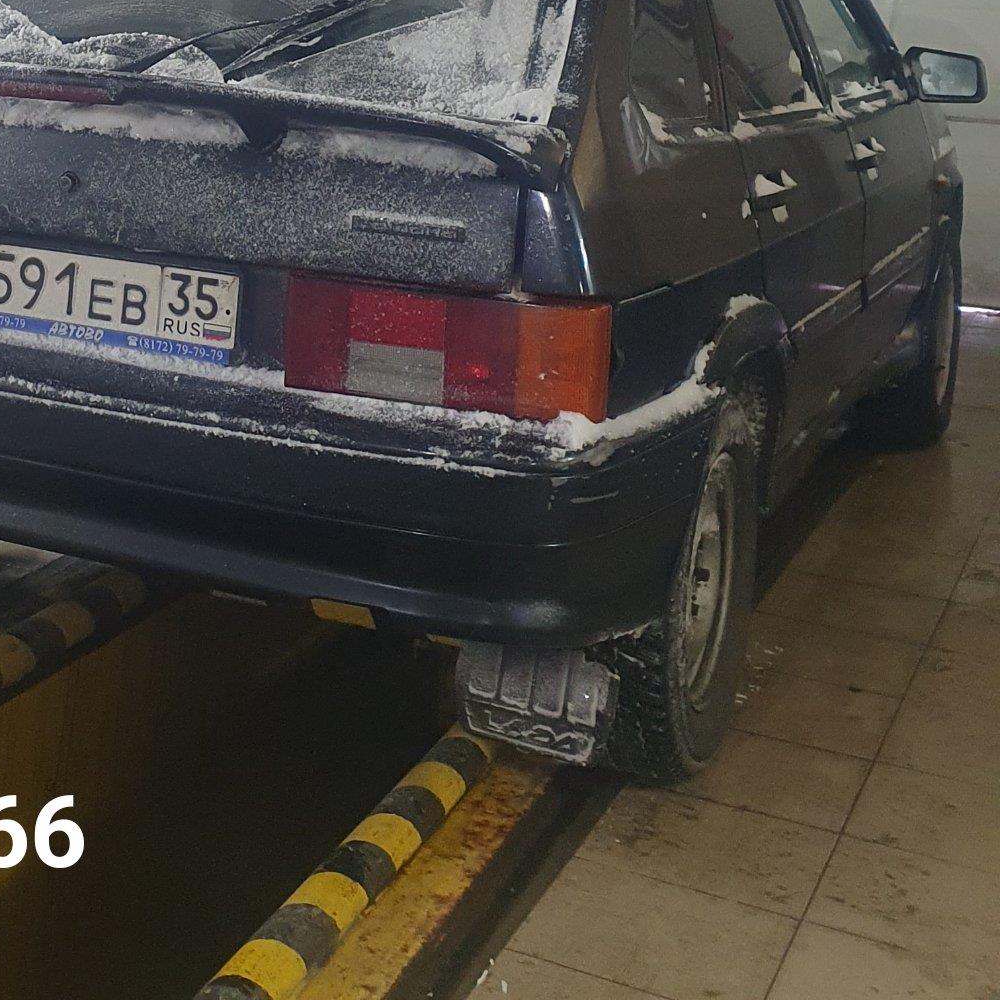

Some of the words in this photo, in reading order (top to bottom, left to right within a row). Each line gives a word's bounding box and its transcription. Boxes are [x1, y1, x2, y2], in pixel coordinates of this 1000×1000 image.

[167, 272, 220, 321] 35
[163, 317, 201, 338] RUS
[139, 336, 173, 354] (8172)
[176, 343, 224, 362] 79-79-79
